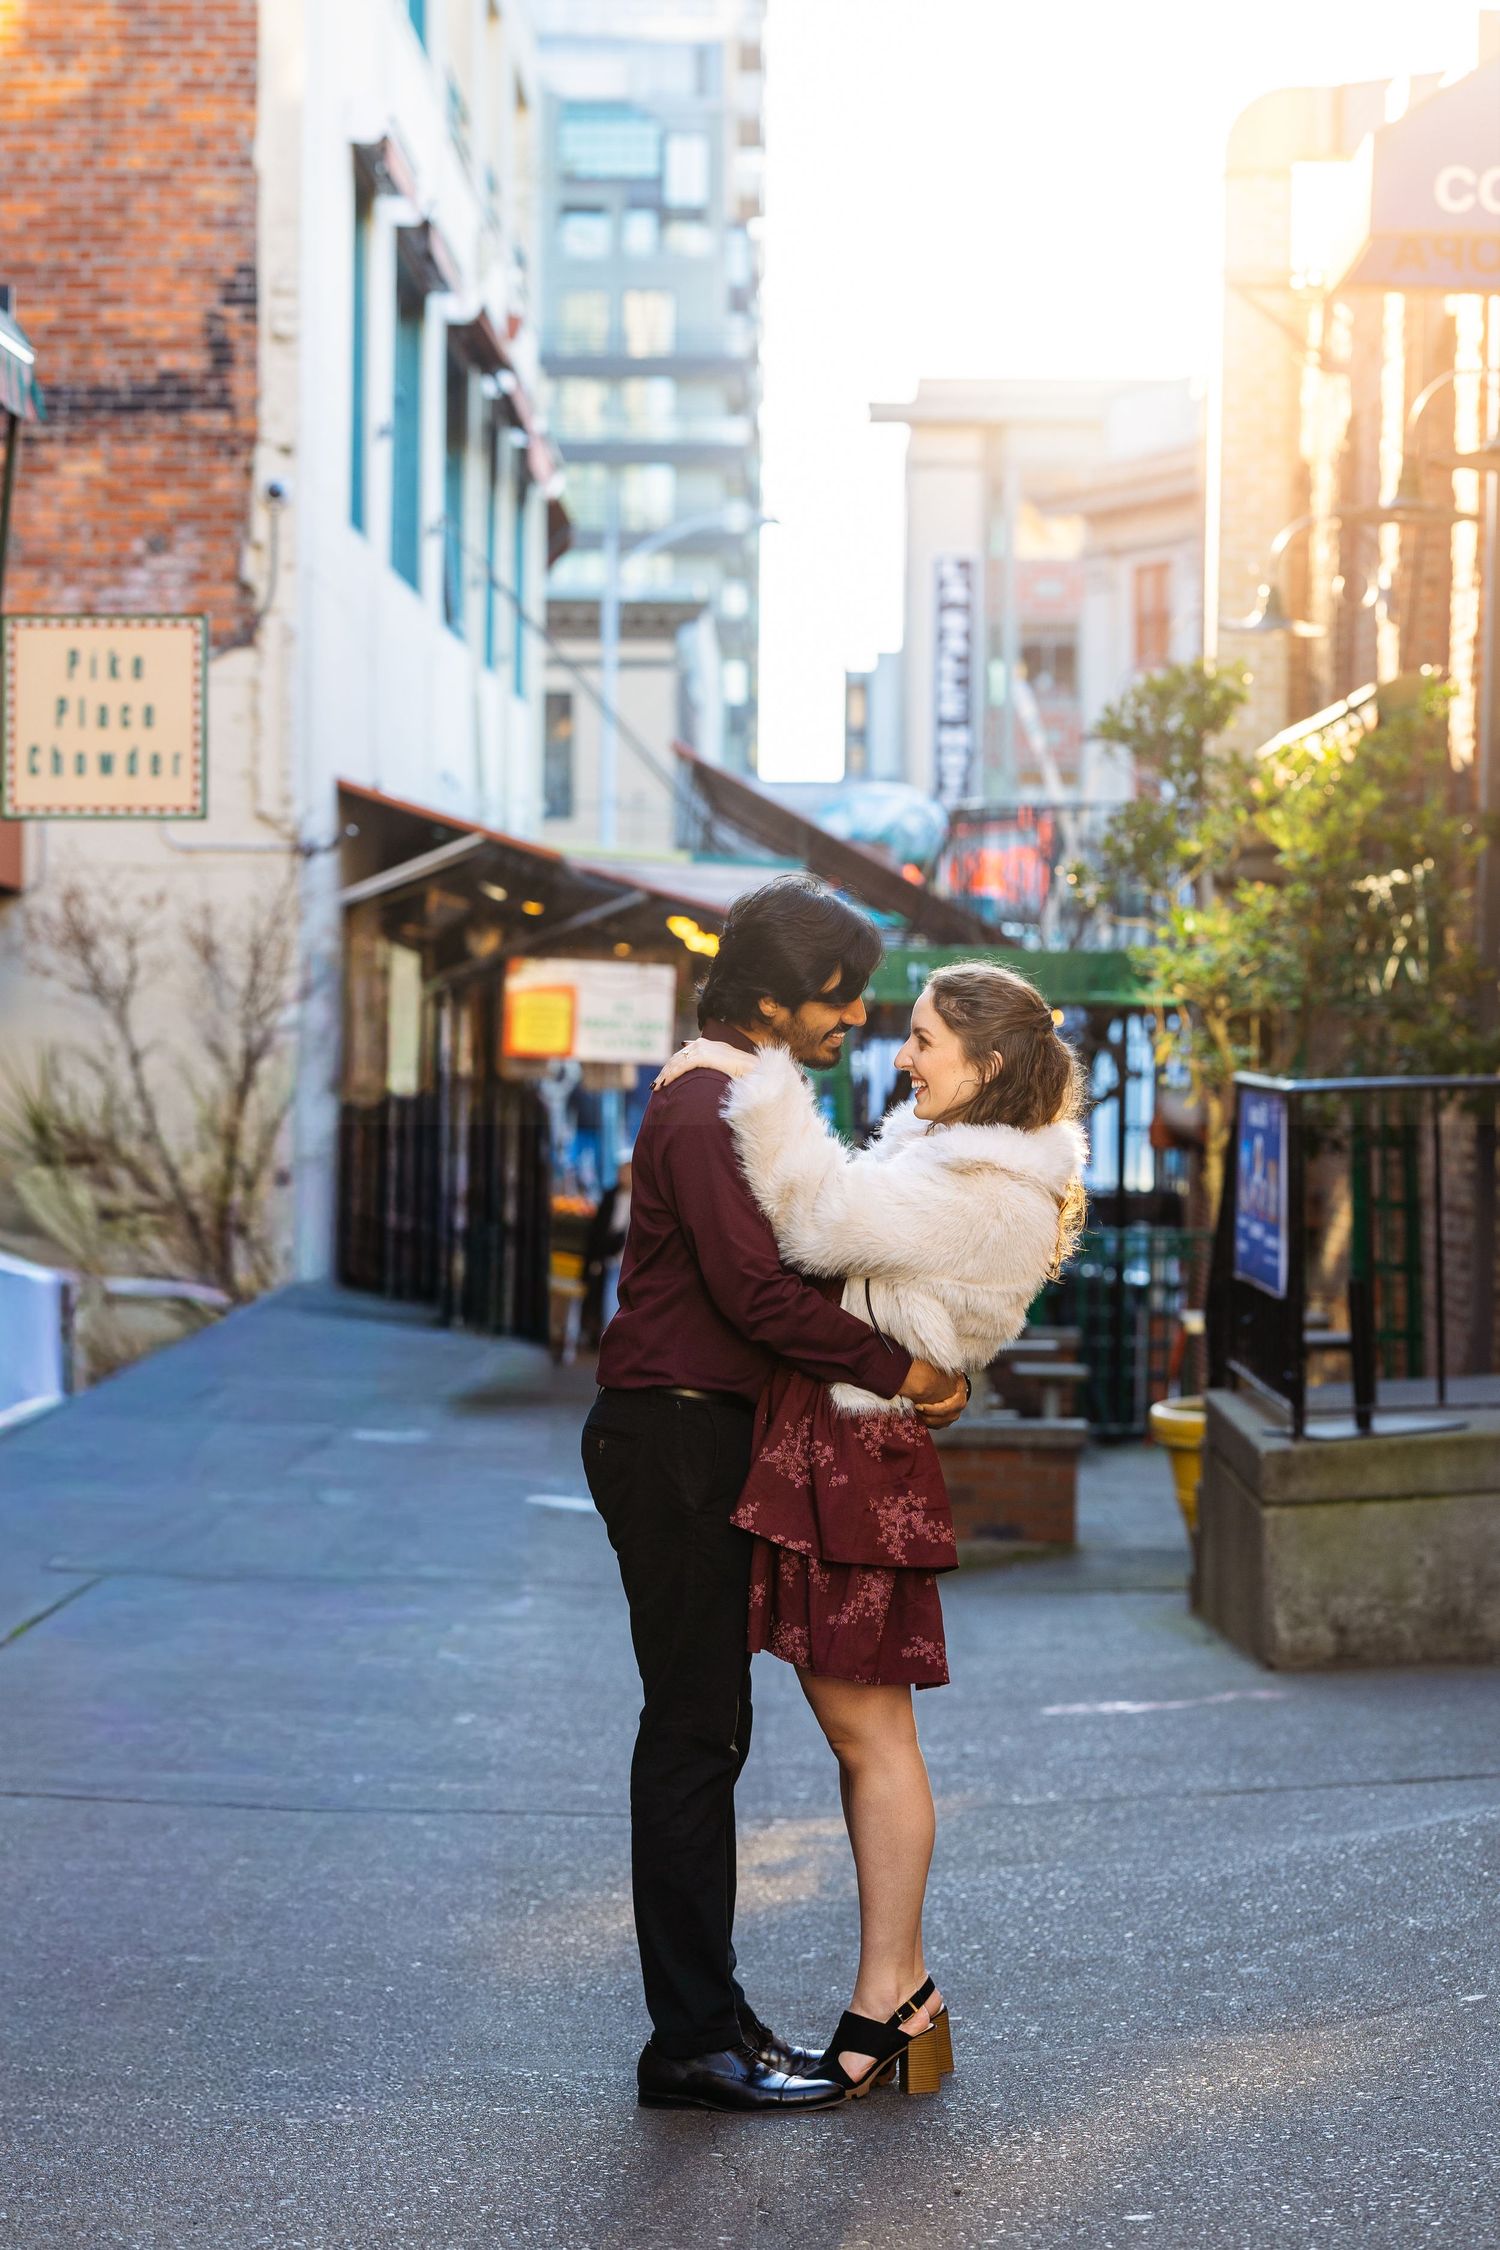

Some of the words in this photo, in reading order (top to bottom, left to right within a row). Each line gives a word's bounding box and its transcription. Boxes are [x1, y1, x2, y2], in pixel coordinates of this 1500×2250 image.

[67, 648, 144, 680] Pike
[56, 696, 154, 729] Place
[27, 744, 182, 777] Chowder
